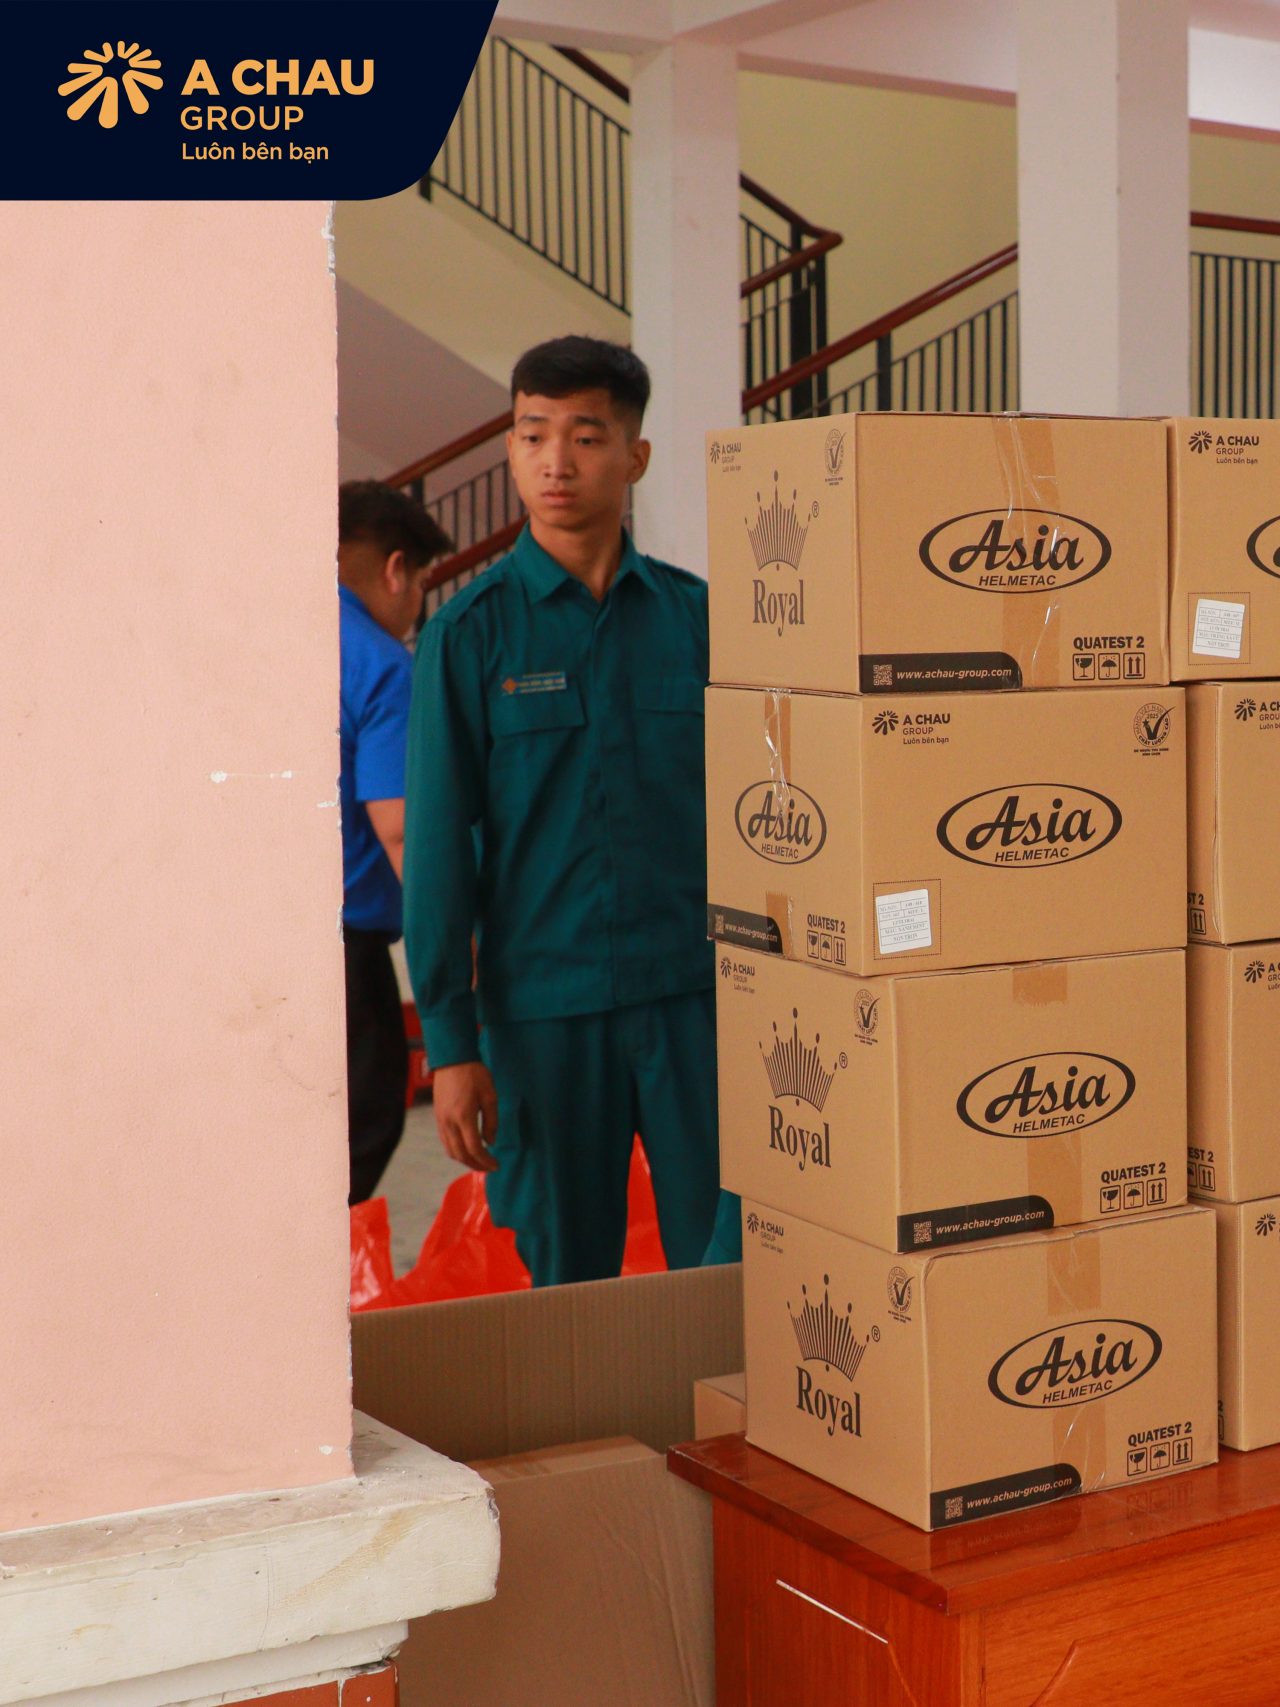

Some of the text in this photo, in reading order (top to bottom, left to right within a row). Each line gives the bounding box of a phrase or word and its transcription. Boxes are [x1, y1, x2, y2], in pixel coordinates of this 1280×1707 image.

[1216, 436, 1260, 446] A CHAU
[1216, 447, 1244, 455] GROUP
[948, 519, 1084, 573] Asia
[978, 574, 1057, 587] HELMETAC
[752, 579, 805, 637] Royal
[1073, 636, 1145, 650] QUATEST 2
[896, 666, 1012, 682] www.achau-group.com
[1260, 702, 1268, 712] A
[903, 713, 951, 726] A CHAU
[902, 726, 934, 736] GROUP
[748, 790, 813, 847] Asia
[965, 796, 1096, 852] Asia
[761, 842, 800, 859] HELMETAC
[994, 847, 1069, 864] HELMETAC
[807, 914, 846, 934] QUATEST 2
[1268, 962, 1275, 973] A
[984, 1065, 1110, 1124] Asia
[1013, 1113, 1085, 1134] HELMETAC
[768, 1104, 832, 1171] Royal
[1101, 1162, 1167, 1184] QUATEST 2
[935, 1209, 1045, 1235] www.achau-group.com
[1015, 1332, 1137, 1396] Asia
[796, 1365, 862, 1439] Royal
[1042, 1379, 1113, 1405] HELMETAC
[1127, 1421, 1192, 1447] QUATEST 2
[966, 1476, 1073, 1510] www.achau-group.com
